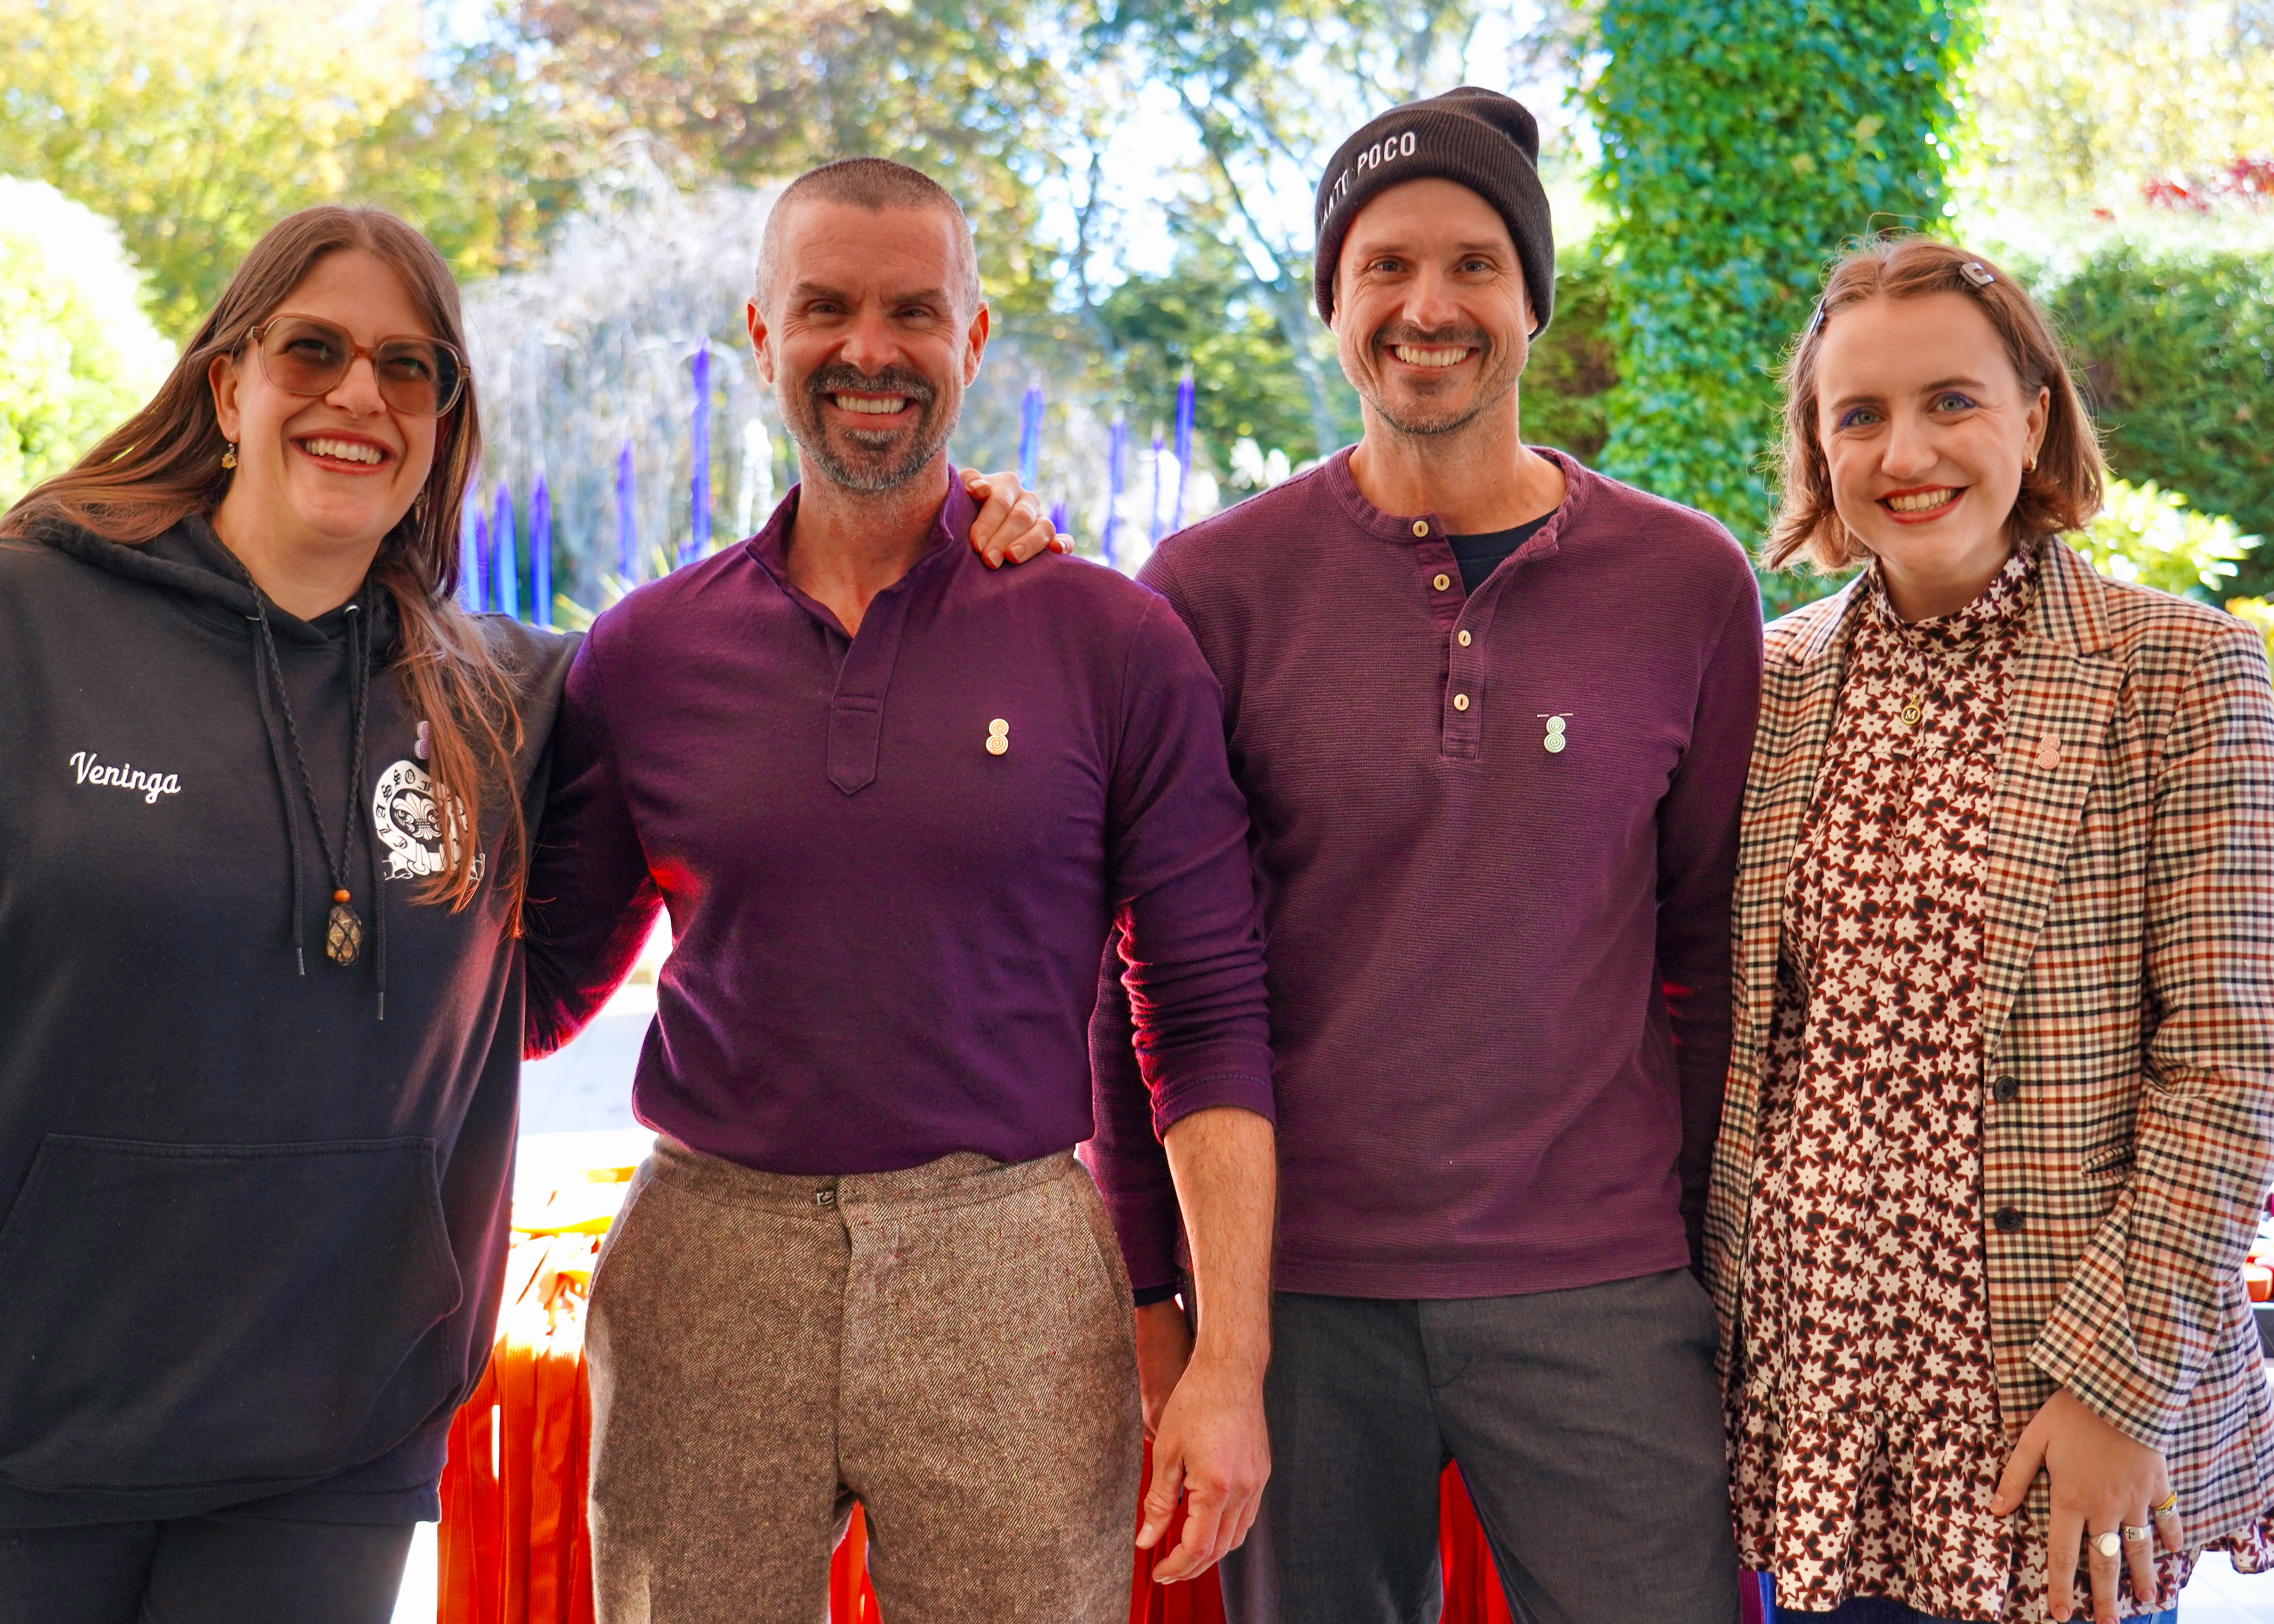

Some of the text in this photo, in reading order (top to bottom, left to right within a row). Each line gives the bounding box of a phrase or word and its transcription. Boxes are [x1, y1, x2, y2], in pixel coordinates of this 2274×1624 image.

[1357, 132, 1415, 178] POCO
[1905, 709, 1917, 720] M
[70, 752, 181, 804] Veninga
